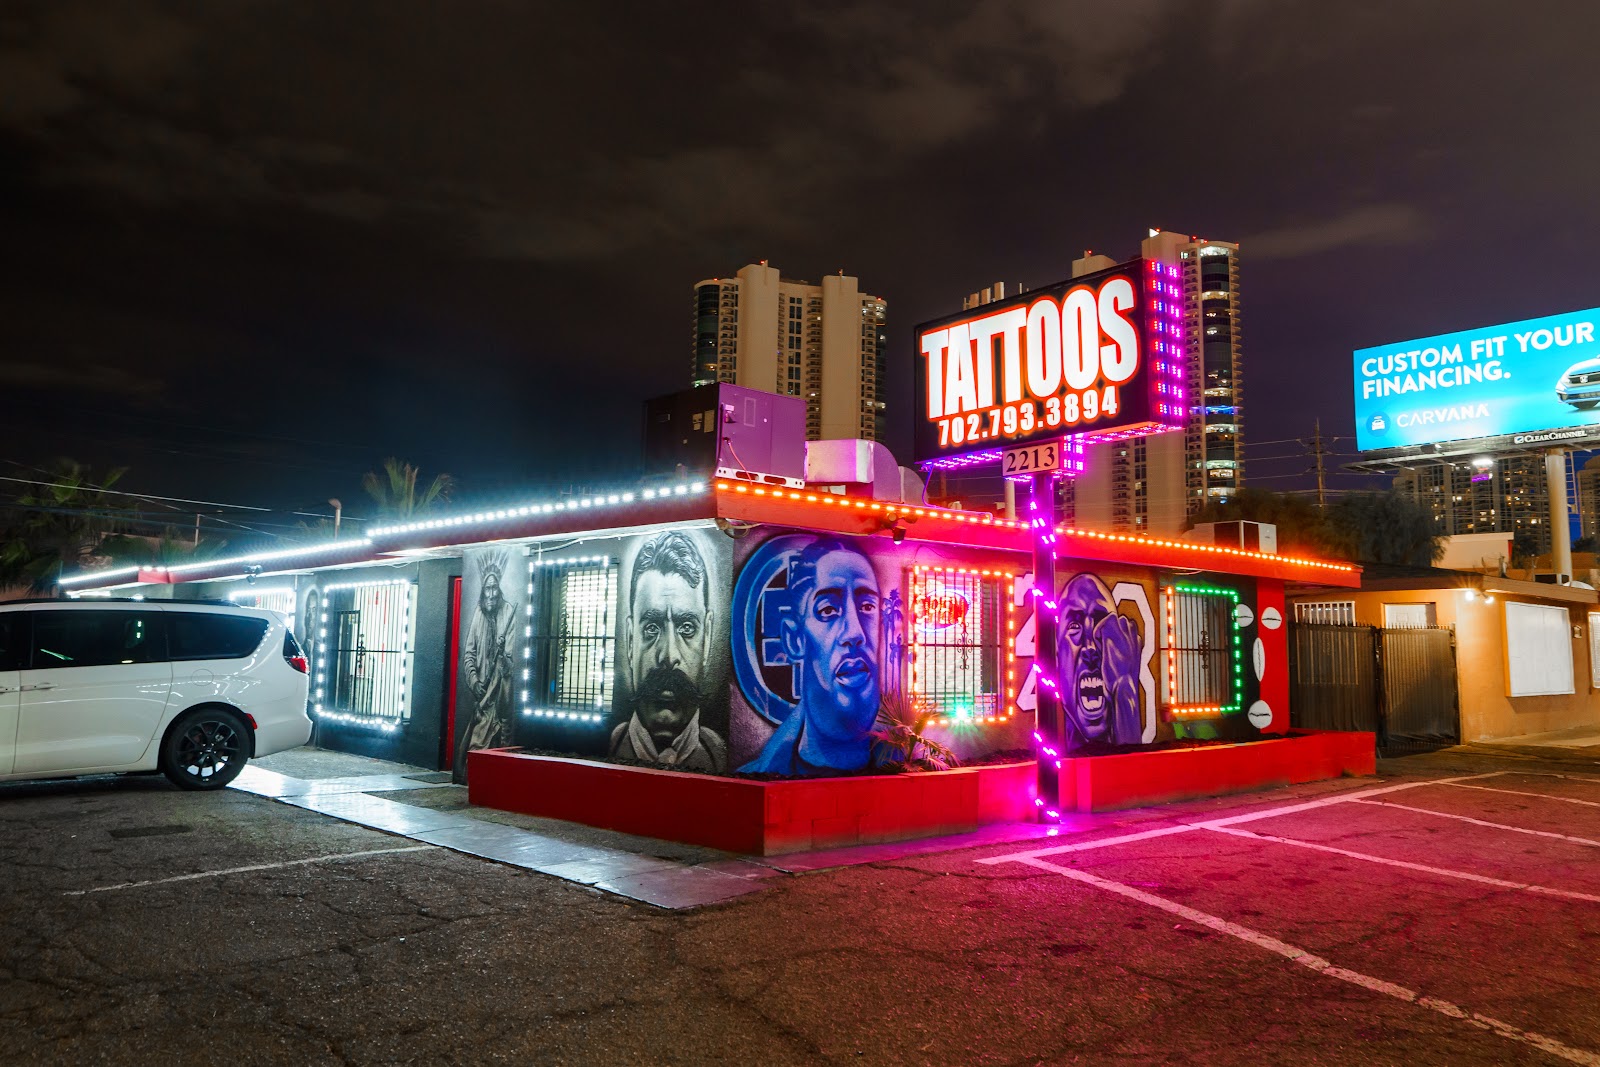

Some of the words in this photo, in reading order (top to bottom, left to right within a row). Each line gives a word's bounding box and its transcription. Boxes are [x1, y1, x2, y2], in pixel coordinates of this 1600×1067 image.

[921, 278, 1138, 418] TATTOOS
[1361, 344, 1463, 377] CUSTOM
[1470, 335, 1507, 361] FIT
[1514, 321, 1595, 352] YOUR
[1362, 360, 1511, 399] FINANCING.
[938, 385, 1117, 446] 702.793.3894
[1396, 403, 1490, 428] CARVANA
[1006, 446, 1056, 473] 2213
